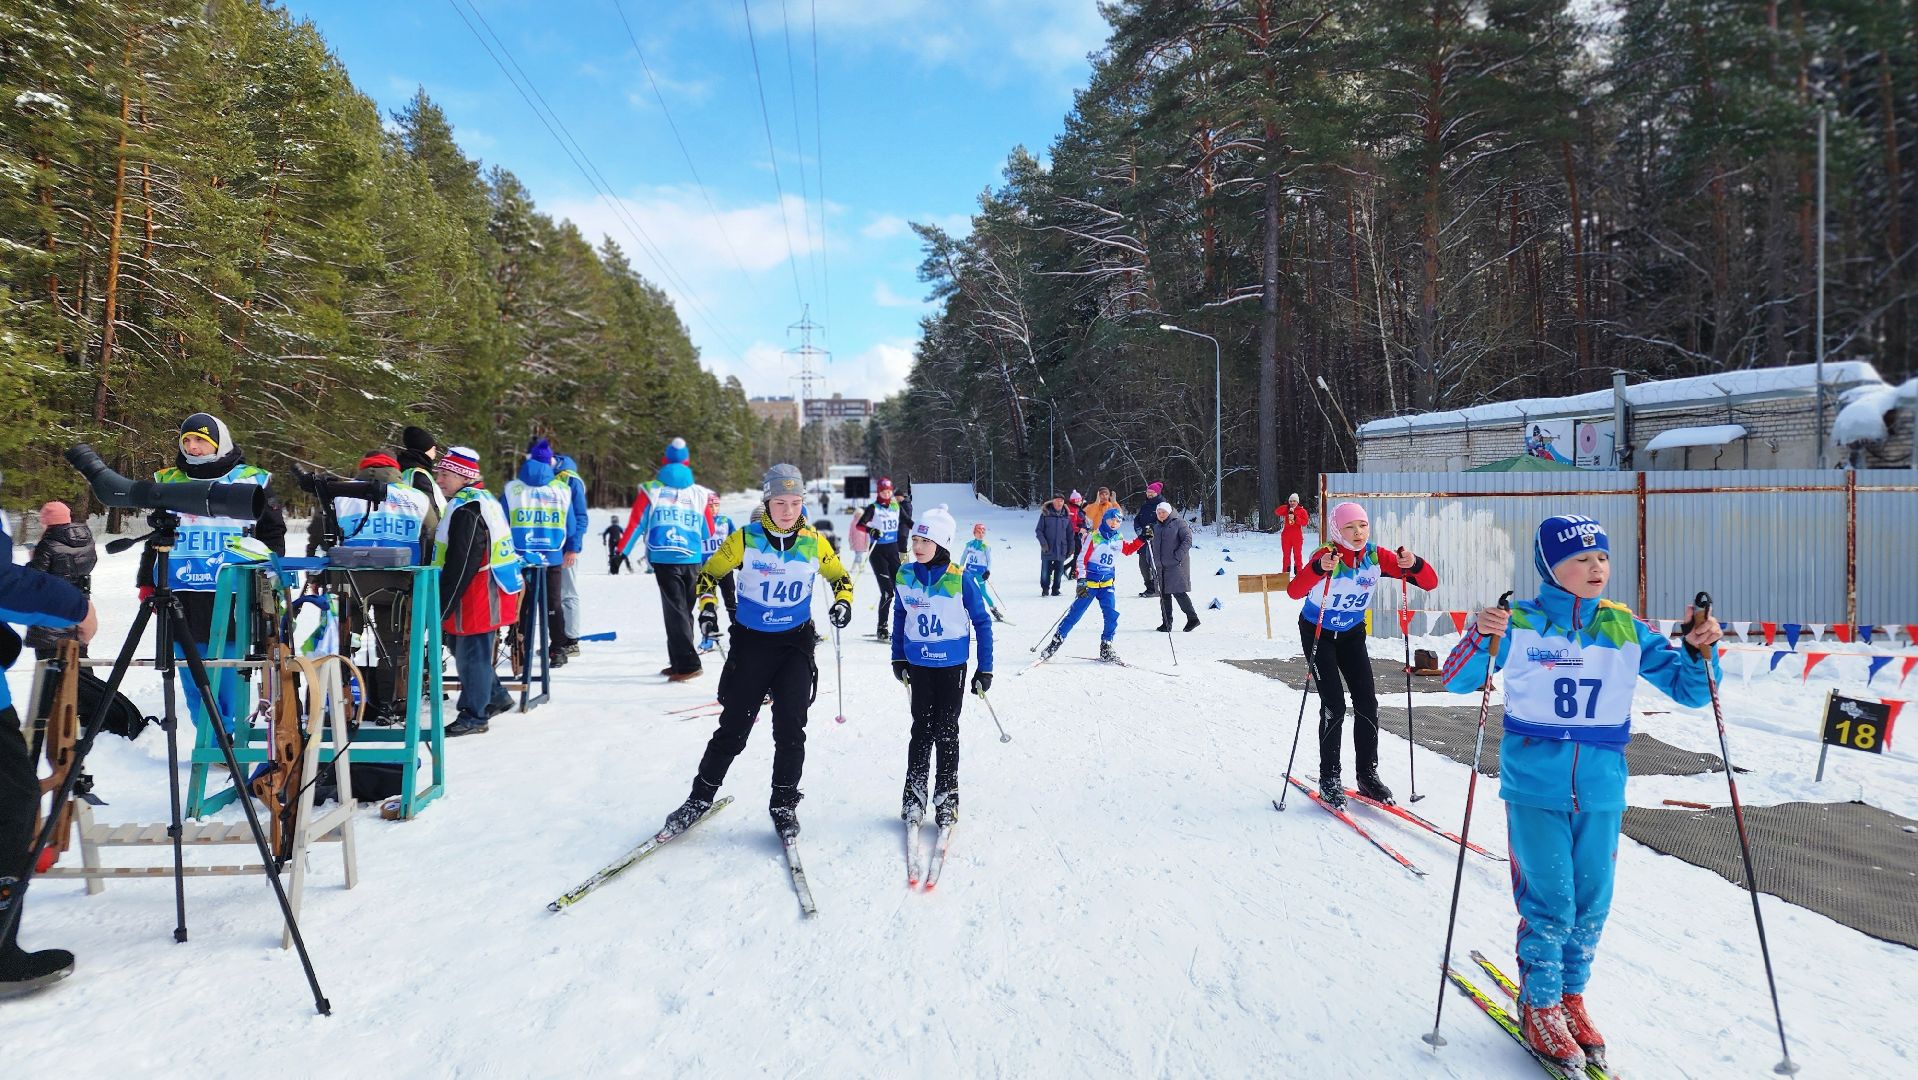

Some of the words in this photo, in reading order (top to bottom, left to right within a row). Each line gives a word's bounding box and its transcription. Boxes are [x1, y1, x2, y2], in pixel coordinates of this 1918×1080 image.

[517, 510, 560, 524] СУДЬЯ
[655, 508, 698, 527] ТРЕЕР
[882, 519, 898, 531] 133
[1099, 552, 1114, 566] 86
[759, 580, 803, 603] 140
[1332, 592, 1370, 610] 139
[917, 613, 944, 638] 84
[1553, 677, 1603, 719] 87
[1835, 720, 1877, 749] 18
